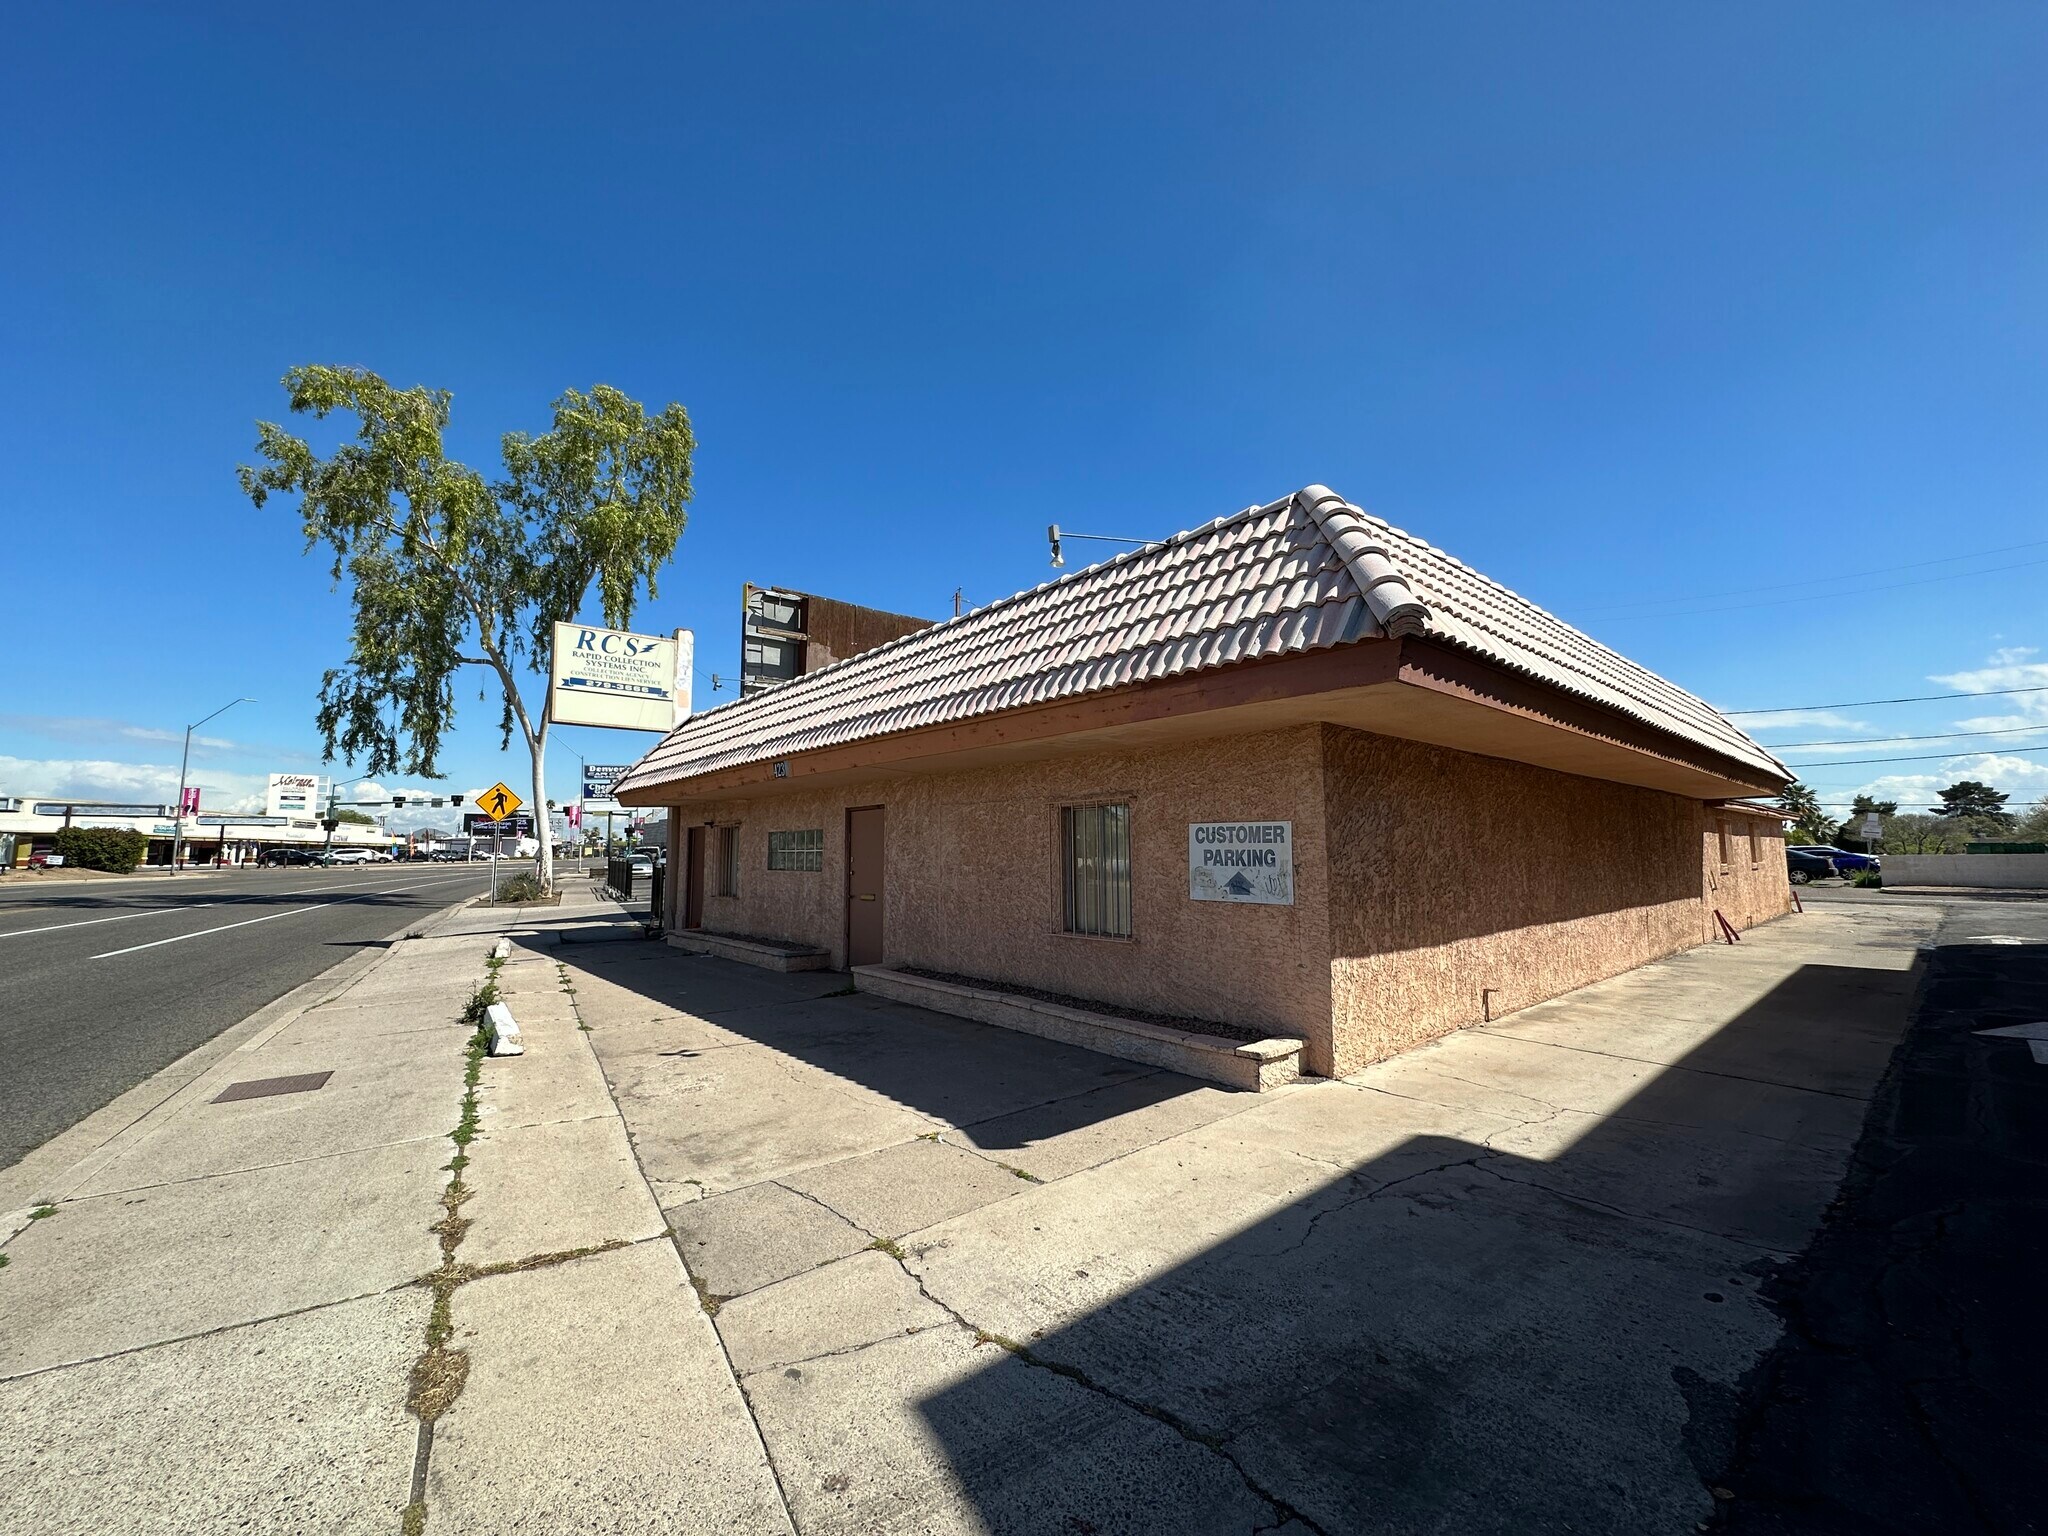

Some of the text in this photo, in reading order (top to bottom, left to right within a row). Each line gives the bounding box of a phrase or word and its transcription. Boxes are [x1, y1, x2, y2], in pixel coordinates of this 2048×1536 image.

[575, 630, 640, 657] RCS
[572, 651, 661, 669] RAPID COLLECTION
[585, 660, 627, 671] SYSTEMS
[570, 670, 621, 681] CONSTRUCTION
[583, 666, 624, 676] COLLECTION
[1195, 825, 1285, 844] CUSTOMER
[1203, 848, 1276, 867] PARKING
